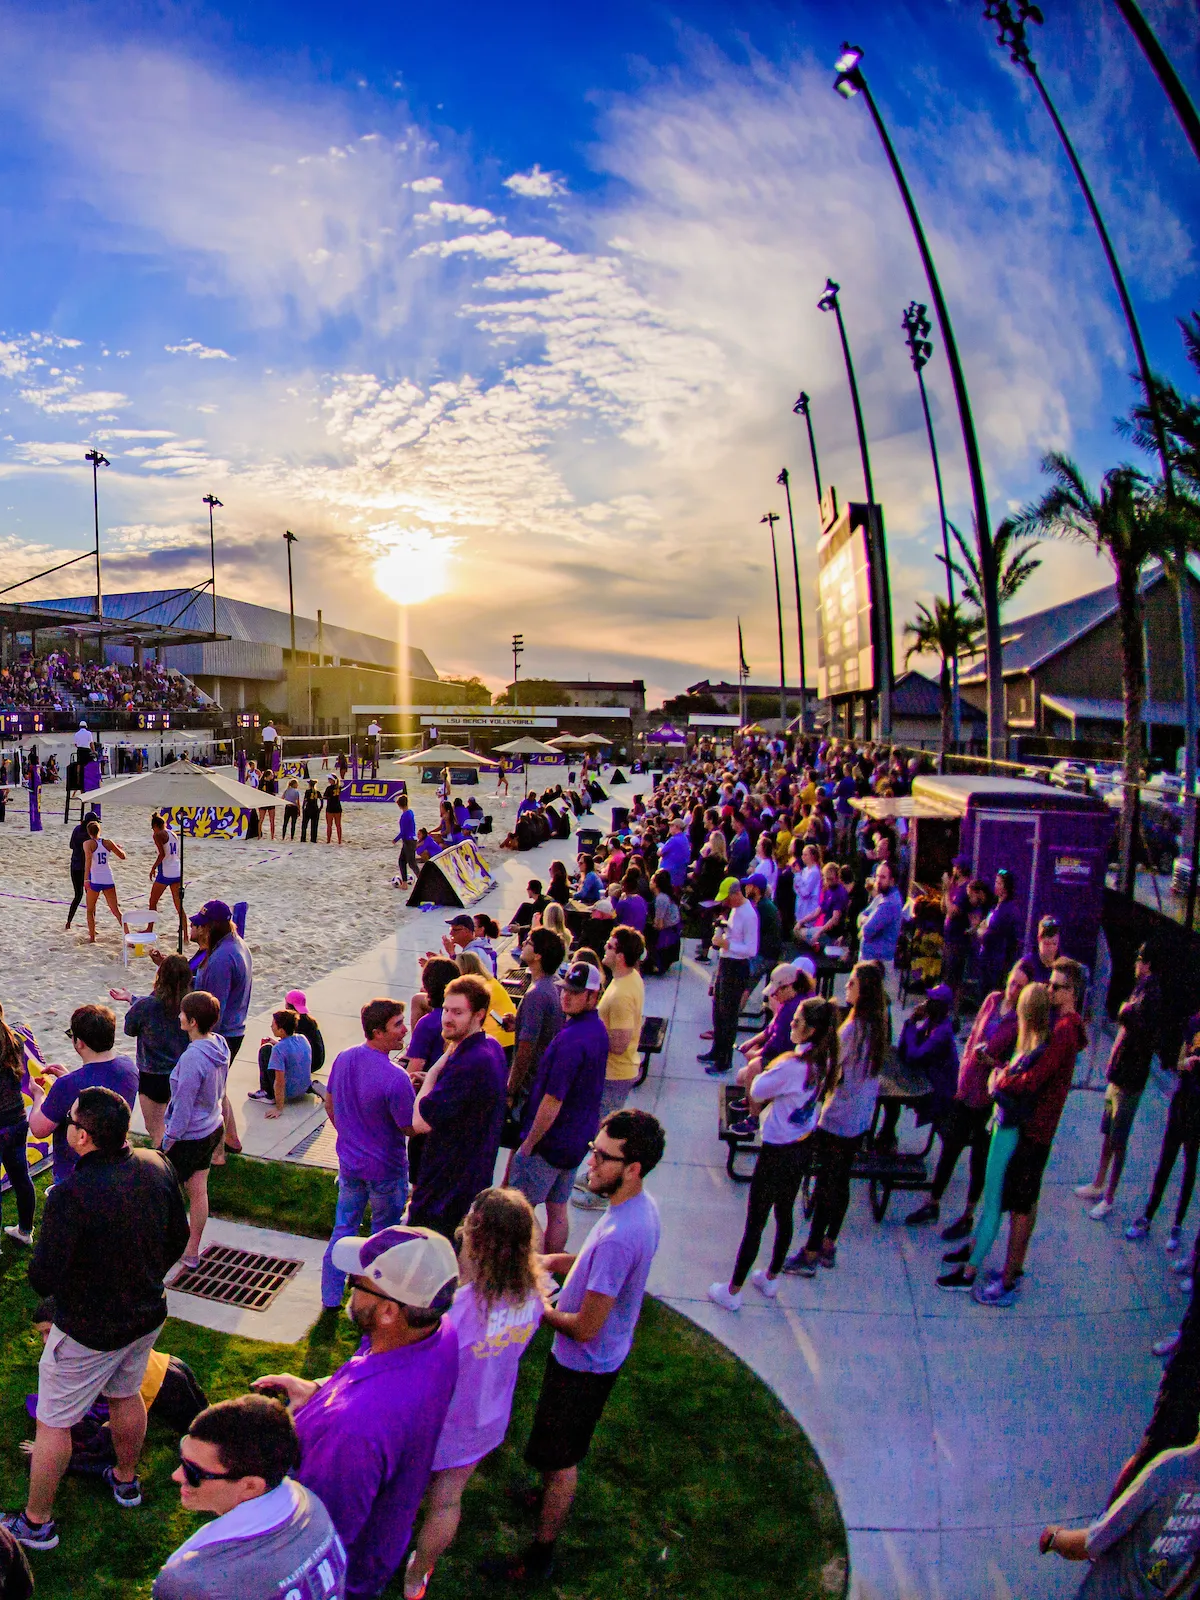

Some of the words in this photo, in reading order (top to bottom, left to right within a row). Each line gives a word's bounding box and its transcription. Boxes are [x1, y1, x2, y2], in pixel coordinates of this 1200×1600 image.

[138, 714, 145, 728] 3
[350, 784, 388, 796] LSU
[169, 842, 177, 855] 14
[98, 852, 106, 864] 15
